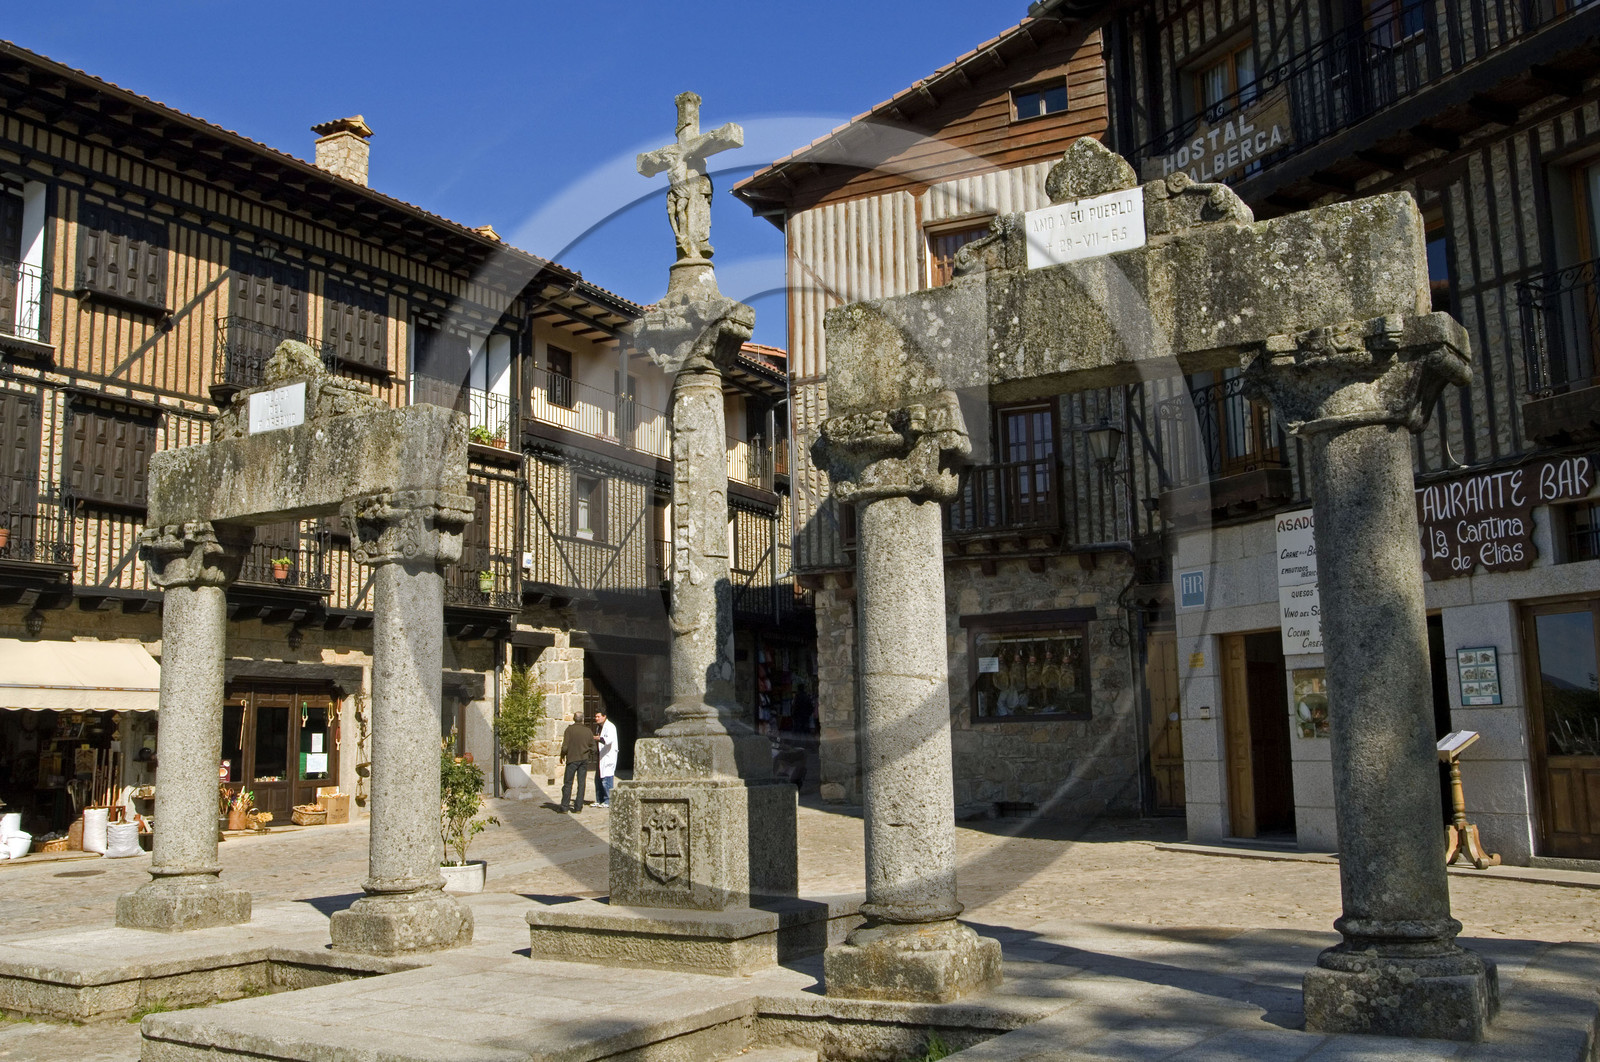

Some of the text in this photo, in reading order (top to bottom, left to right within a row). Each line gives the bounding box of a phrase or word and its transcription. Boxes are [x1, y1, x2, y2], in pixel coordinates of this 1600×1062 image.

[1163, 114, 1254, 177] HOSTAL
[1190, 124, 1282, 183] ALBERCA
[1060, 214, 1067, 228] A
[1070, 209, 1084, 225] SU
[1089, 199, 1133, 221] PUEBLO
[1414, 456, 1589, 523] AURANTE BAR
[1429, 516, 1525, 560] La Cantina
[1451, 541, 1524, 571] de Elias
[1291, 589, 1314, 599] QUESOS
[1287, 626, 1310, 638] COCINA
